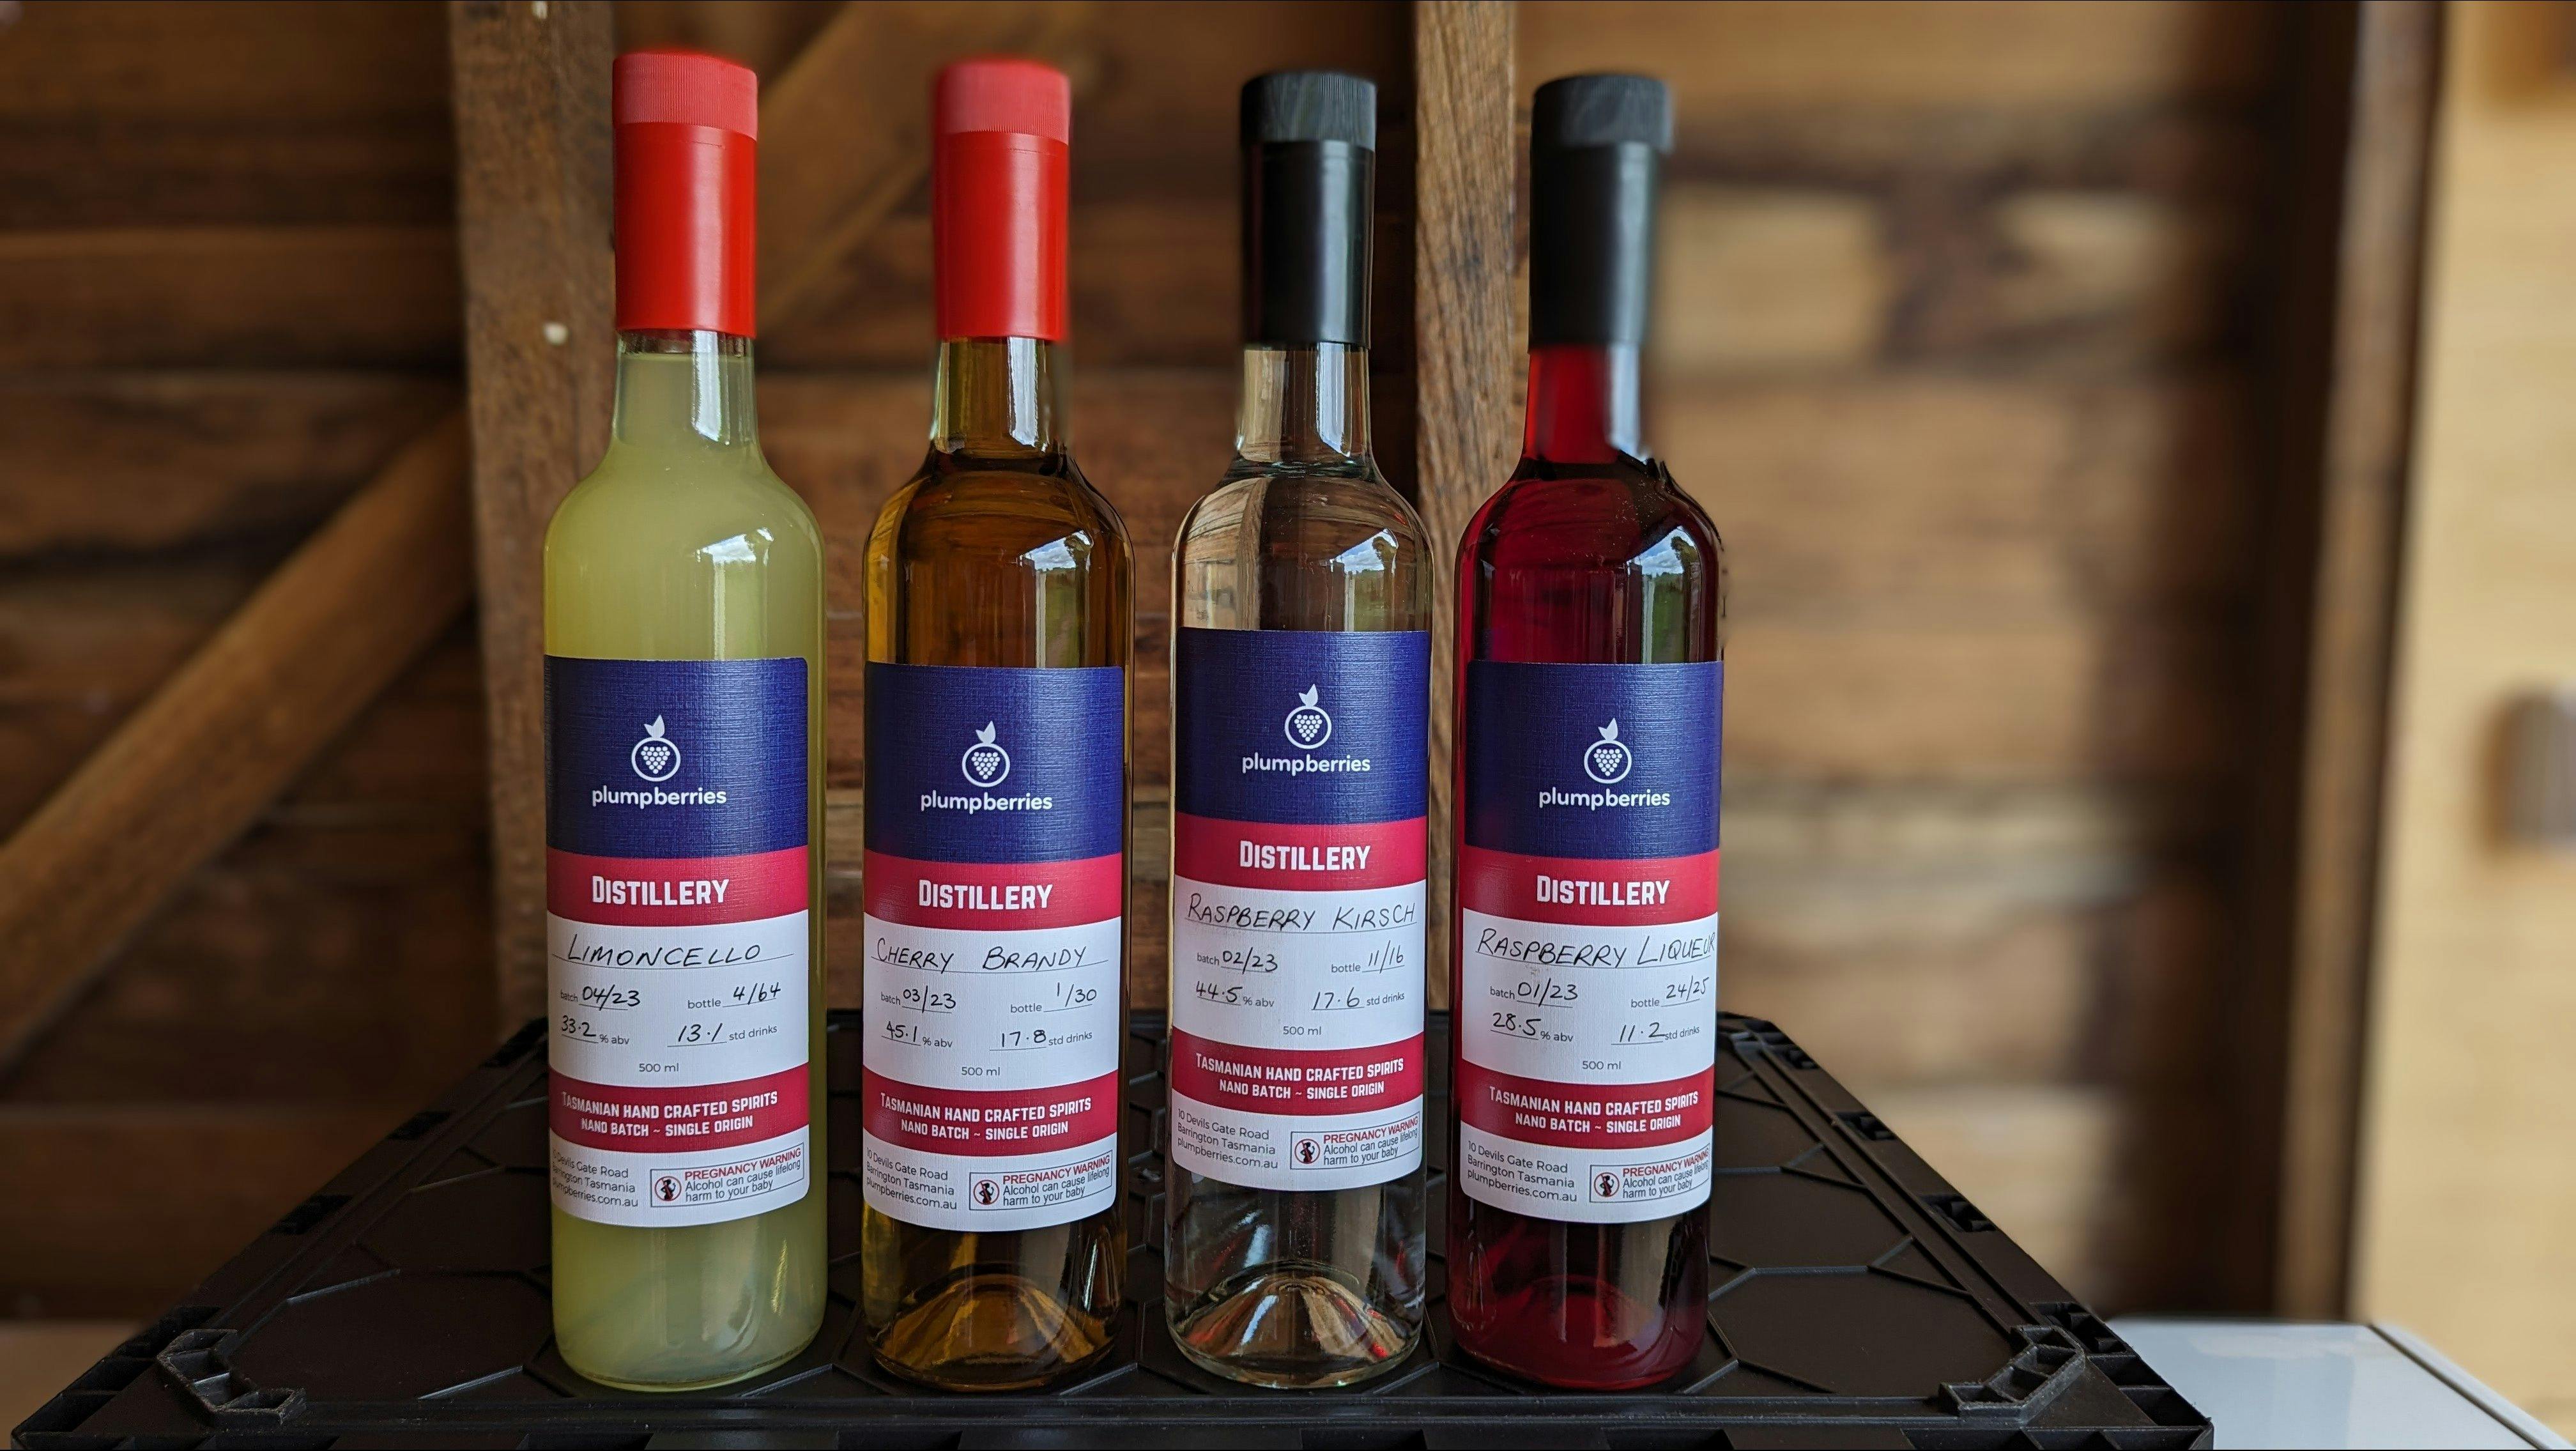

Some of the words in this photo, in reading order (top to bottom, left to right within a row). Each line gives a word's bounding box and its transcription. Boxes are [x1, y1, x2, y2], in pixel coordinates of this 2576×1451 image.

[1242, 752, 1370, 776] plumpberries
[592, 785, 727, 809] plumpberries
[921, 790, 1053, 815] plumpberries
[1539, 787, 1670, 811] plumpberries
[1188, 893, 1316, 932] RASPBERRY
[1333, 902, 1416, 930] KIRSCH
[568, 934, 761, 967] LIMONCELLO
[877, 937, 954, 974] CHERRY
[982, 946, 1087, 972] BRANDY
[1197, 952, 1220, 966] batch
[1222, 947, 1278, 974] 02/23
[1331, 963, 1361, 973] bottle
[1368, 940, 1404, 974] 11/16
[1477, 928, 1627, 969] RASPBERRY
[1637, 931, 1715, 965] LIQUEUR
[560, 990, 578, 1002] batch
[582, 985, 641, 1011] 04/23
[687, 997, 721, 1009] bottle
[733, 982, 781, 1005] 4/64
[881, 992, 901, 1005] batch
[903, 985, 956, 1013] 03/23
[1010, 1002, 1042, 1013] bottle
[1056, 982, 1097, 1007] 1/30
[1196, 981, 1243, 1003] 44.5
[1255, 998, 1274, 1008] abv
[1312, 987, 1360, 1010] 17.6
[1366, 997, 1380, 1006] std
[1382, 992, 1405, 1003] drinks
[1490, 986, 1515, 1000] batch
[1517, 978, 1578, 1007] 01/23
[1631, 998, 1660, 1008] bottle
[1666, 975, 1709, 1001] 24/25
[611, 1036, 629, 1045] abv
[729, 1030, 746, 1041] std
[749, 1025, 778, 1038] drinks
[1001, 1029, 1046, 1048] 17.8
[1048, 1036, 1064, 1046] std
[1066, 1031, 1092, 1043] drinks
[1283, 1026, 1305, 1035] 500
[1307, 1026, 1322, 1035] ml
[1492, 1013, 1542, 1036] 28.5
[1554, 1034, 1574, 1043] abv
[1665, 1031, 1678, 1040] std
[1680, 1026, 1700, 1038] drinks
[934, 1038, 953, 1048] abv
[639, 1063, 661, 1072] 500
[664, 1063, 679, 1072] ml
[961, 1067, 983, 1076] 500
[986, 1066, 1000, 1076] ml
[1196, 1053, 1262, 1079] TASMANIAN
[1266, 1067, 1301, 1082] HAND
[1306, 1065, 1363, 1082] CRAFTED
[1367, 1058, 1404, 1077] SPIRITS
[1582, 1061, 1604, 1070] 500
[1607, 1061, 1621, 1070] ml
[1220, 1079, 1248, 1095] NANO
[1252, 1084, 1291, 1099] BATCH
[1307, 1086, 1348, 1100] SINGLE
[1352, 1080, 1384, 1097] ORIGIN
[1489, 1086, 1560, 1113] TASMANIAN
[1565, 1101, 1601, 1116] HAND
[1605, 1099, 1661, 1116] CRAFTED
[1665, 1091, 1698, 1111] SPIRITS
[563, 1092, 620, 1117] TASMANIAN
[624, 1104, 659, 1119] HAND
[664, 1101, 728, 1119] CRAFTED
[732, 1091, 778, 1112] SPIRITS
[881, 1092, 940, 1119] TASMANIAN
[944, 1108, 980, 1123] HAND
[985, 1106, 1045, 1123] CRAFTED
[1049, 1098, 1091, 1117] SPIRITS
[611, 1121, 648, 1137] BATCH
[665, 1121, 712, 1137] SINGLE
[714, 1116, 753, 1132] ORIGIN
[901, 1119, 928, 1135] NANO
[931, 1123, 969, 1140] BATCH
[985, 1125, 1029, 1140] SINGLE
[1032, 1121, 1068, 1137] ORIGIN
[1178, 1108, 1185, 1120] 10
[1186, 1114, 1210, 1130] Devils
[1211, 1122, 1236, 1136] Gate
[1239, 1127, 1269, 1140] Road
[1324, 1128, 1388, 1144] PREGNANCY
[1388, 1116, 1418, 1136] WARNING
[1515, 1112, 1546, 1130] NANO
[1550, 1117, 1590, 1132] BATCH
[1606, 1119, 1647, 1133] SINGLE
[1650, 1114, 1681, 1130] ORIGIN
[1177, 1123, 1218, 1147] Barrington
[1222, 1139, 1275, 1155] Tasmania
[1324, 1142, 1358, 1156] Alcohol
[1360, 1141, 1376, 1151] can
[1377, 1137, 1399, 1149] cause
[685, 1162, 758, 1181] PREGNANCY
[760, 1148, 801, 1168] WARNING
[1177, 1137, 1278, 1169] plumpberries.com.au
[1324, 1155, 1348, 1165] harm
[1351, 1153, 1359, 1163] to
[1361, 1151, 1381, 1165] your
[1383, 1146, 1399, 1158] baby
[1468, 1140, 1476, 1152] 10
[1478, 1146, 1505, 1163] Devils
[1507, 1155, 1533, 1169] Gate
[1537, 1160, 1568, 1173] Road
[577, 1162, 597, 1175] Gate
[601, 1166, 629, 1178] Road
[867, 1162, 901, 1186] Barrington
[903, 1178, 955, 1196] Tasmania
[873, 1152, 893, 1166] Devils
[895, 1163, 917, 1176] Gate
[920, 1167, 948, 1181] Road
[1002, 1169, 1071, 1185] PREGNANCY
[1073, 1155, 1110, 1174] WARNING
[1468, 1155, 1514, 1179] Barrington
[1517, 1171, 1575, 1188] Tasmania
[1623, 1160, 1682, 1178] PREGNANCY
[585, 1178, 636, 1193] Tasmania
[686, 1179, 723, 1192] Alcohol
[726, 1177, 744, 1187] can
[747, 1171, 773, 1185] cause
[686, 1191, 712, 1202] harm
[716, 1188, 725, 1199] to
[728, 1185, 749, 1200] your
[752, 1179, 774, 1193] baby
[1003, 1184, 1039, 1196] Alcohol
[1042, 1182, 1059, 1192] can
[1061, 1176, 1085, 1190] cause
[1468, 1169, 1577, 1202] plumpberries.com.au
[1622, 1174, 1655, 1188] Alcohol
[1658, 1174, 1673, 1183] can
[1622, 1188, 1646, 1198] harm
[1648, 1185, 1657, 1196] to
[1659, 1183, 1678, 1197] your
[1003, 1196, 1028, 1206] harm
[1031, 1193, 1040, 1204] to
[1043, 1190, 1063, 1205] your
[1066, 1185, 1085, 1199] baby
